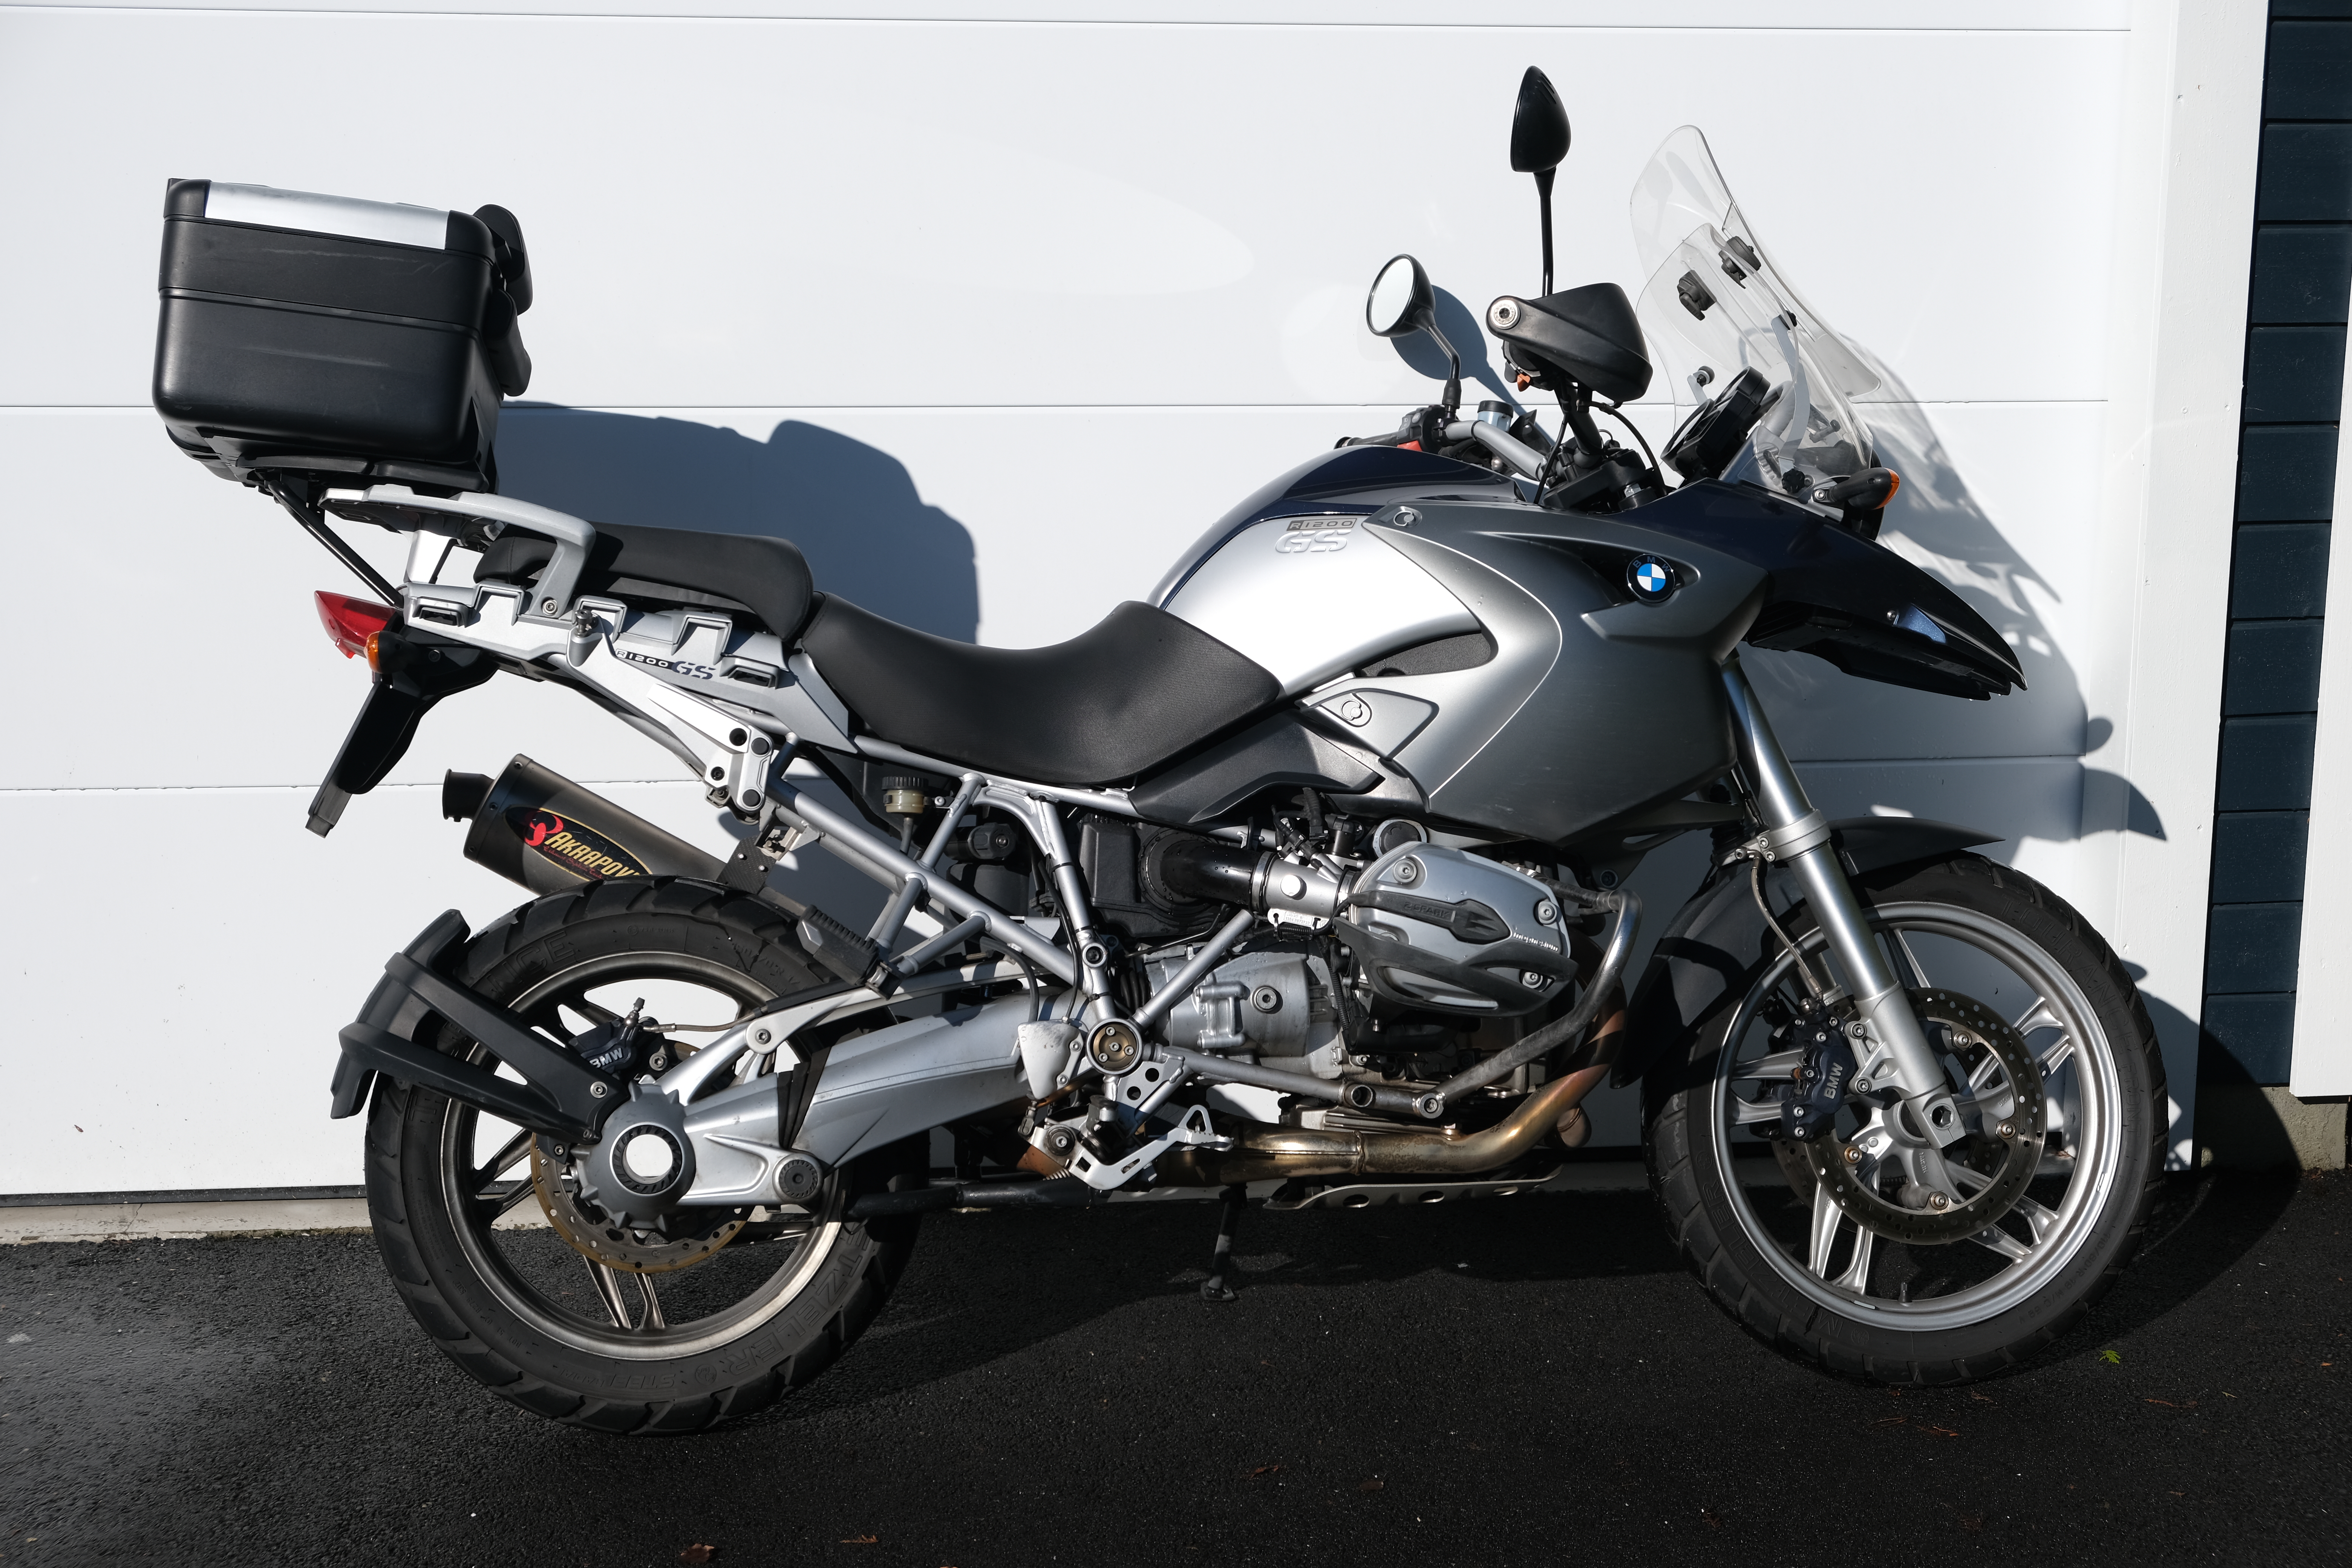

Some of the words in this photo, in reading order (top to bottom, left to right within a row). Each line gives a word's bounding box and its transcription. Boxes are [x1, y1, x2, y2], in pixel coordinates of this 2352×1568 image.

[1289, 520, 1354, 530] R1200
[1275, 530, 1352, 553] GS
[1632, 556, 1670, 572] BMW
[616, 649, 668, 668] R1200
[671, 661, 716, 680] GS
[544, 832, 640, 877] AKRAPOV
[1413, 905, 1450, 919] SPARK
[1513, 932, 1559, 952] magnesium
[1995, 893, 2139, 1055] TOURANCE
[2121, 1061, 2141, 1138] FRONT
[589, 1047, 623, 1068] BMW
[1824, 1062, 1843, 1099] BMW
[1700, 1178, 1844, 1338] METZELER
[724, 1229, 871, 1379] ETZELER
[602, 1372, 677, 1390] STEEL
